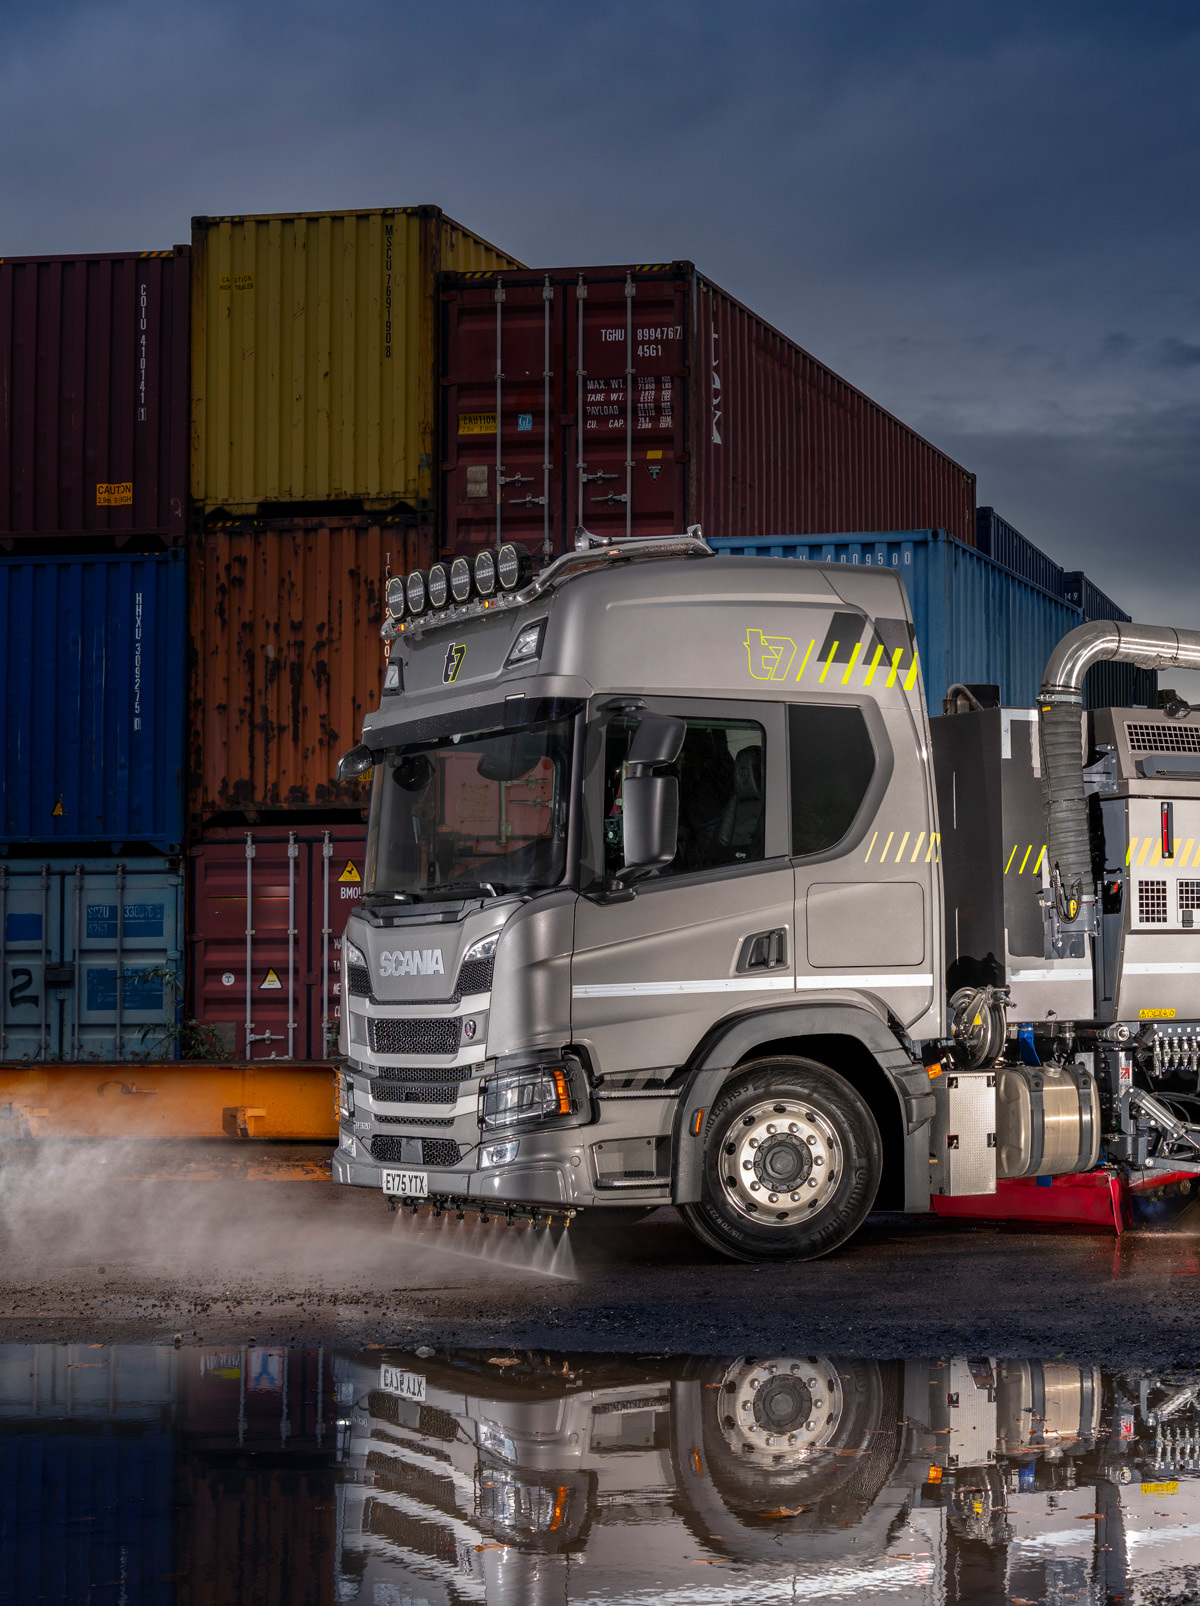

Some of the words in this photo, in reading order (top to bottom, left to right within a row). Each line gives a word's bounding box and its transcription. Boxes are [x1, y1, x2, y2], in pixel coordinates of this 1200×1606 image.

[385, 225, 393, 271] MSCU
[601, 329, 625, 341] TGHU
[637, 327, 674, 341] 899476
[674, 325, 682, 339] 7
[385, 345, 391, 358] 8
[637, 345, 662, 357] 45G1
[586, 380, 608, 389] MAX.
[611, 379, 626, 389] WT.
[587, 393, 606, 401] TARE
[610, 392, 625, 401] WT.
[586, 405, 619, 416] PAYLOAD
[463, 416, 496, 425] CAUTION
[587, 420, 598, 429] CU.
[608, 419, 625, 428] CAP.
[98, 485, 131, 494] CAUTON
[379, 949, 444, 977] SCANIA
[9, 968, 39, 1008] 2
[728, 1088, 742, 1102] HS
[385, 1173, 407, 1192] EY75
[408, 1174, 425, 1194] YTX
